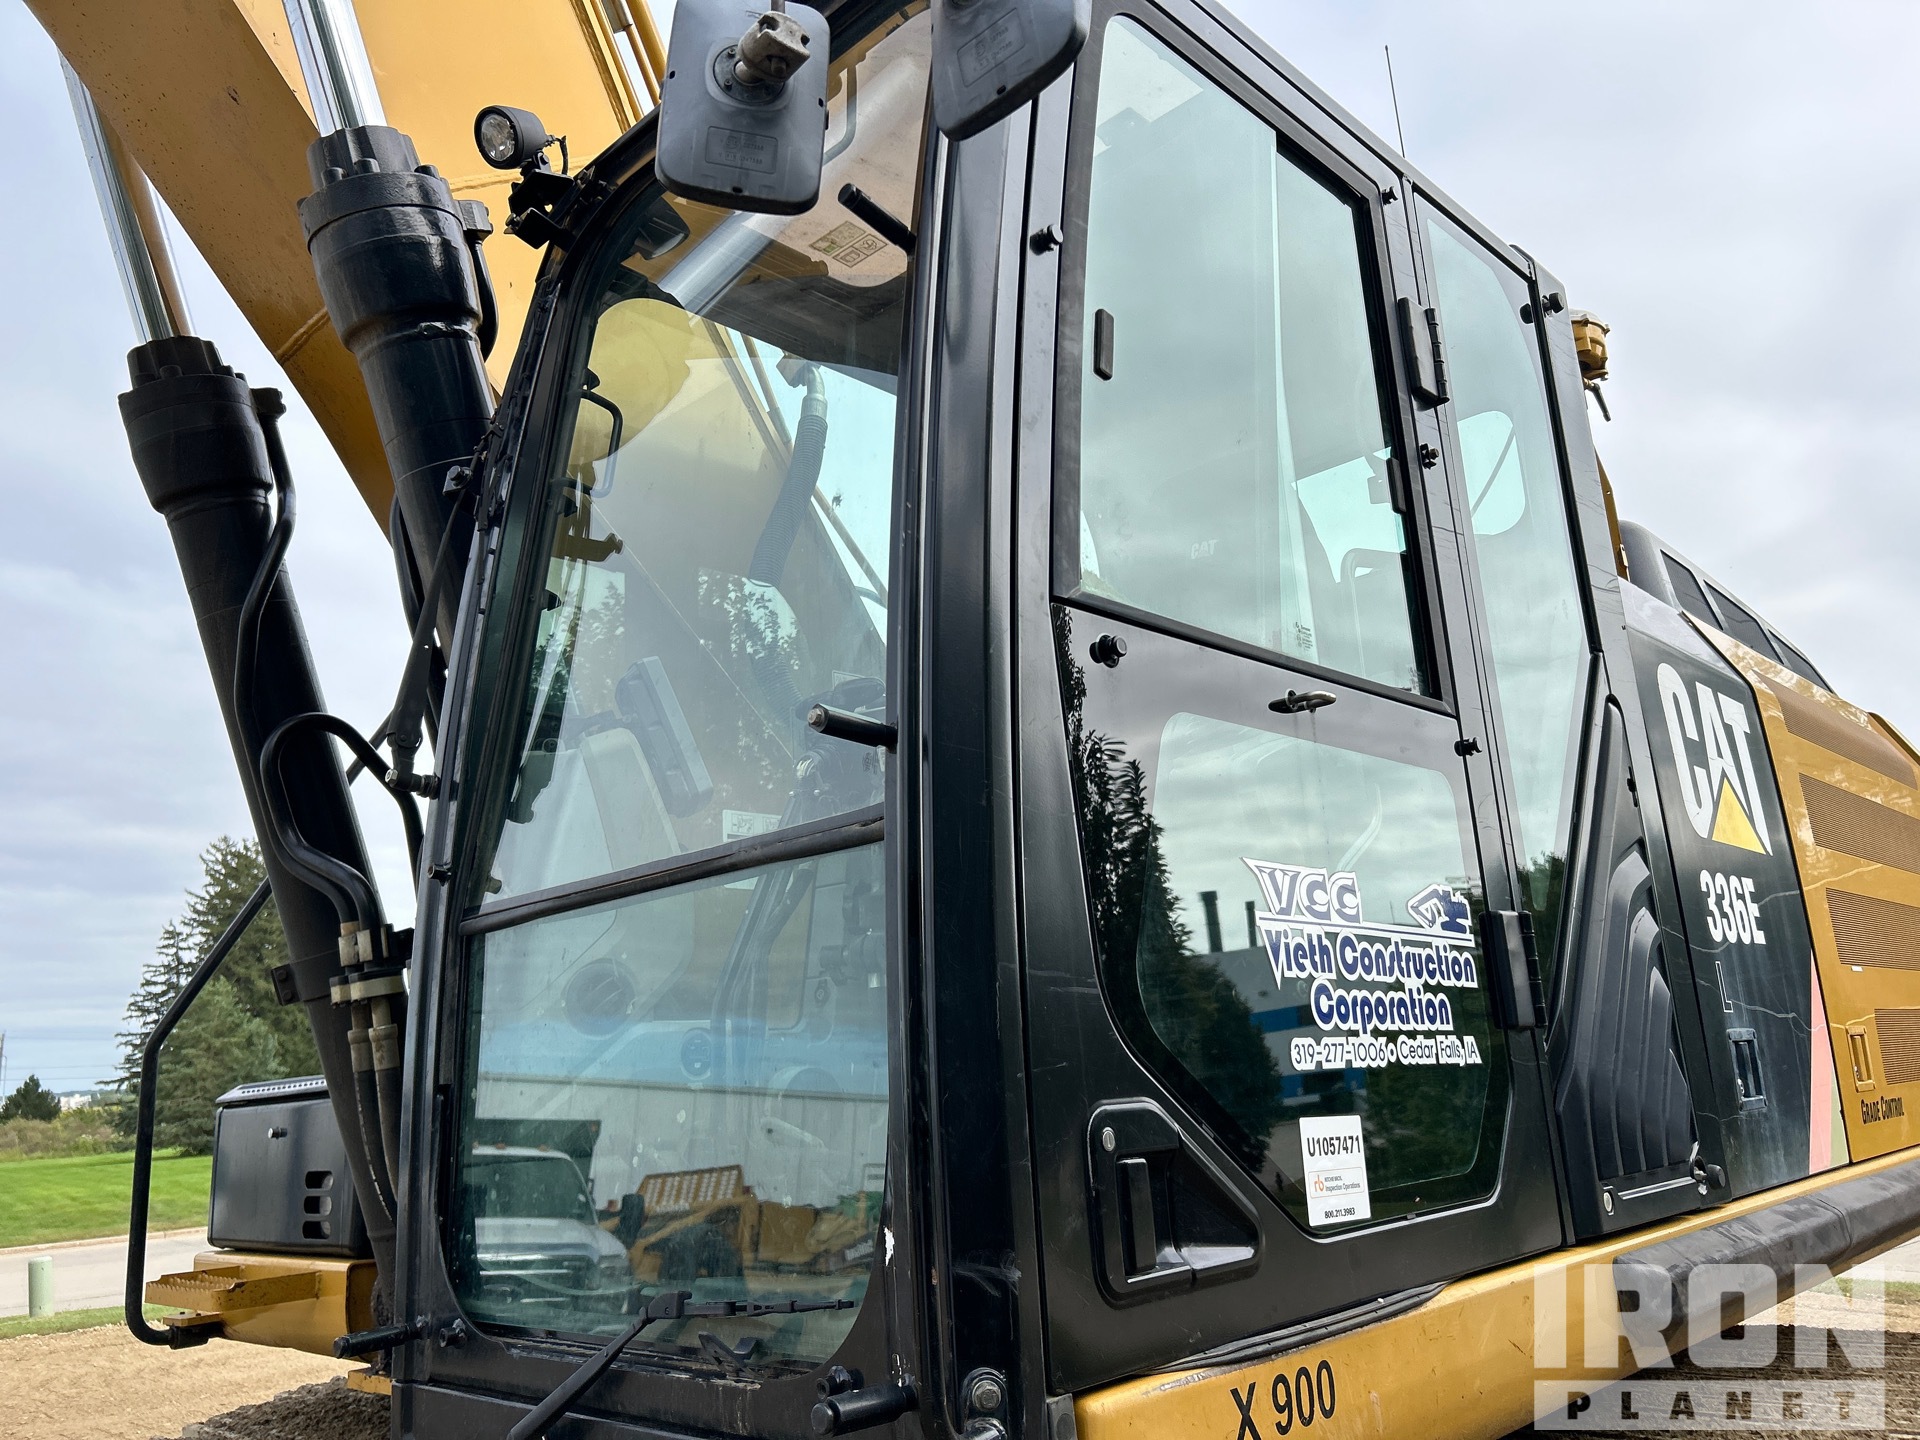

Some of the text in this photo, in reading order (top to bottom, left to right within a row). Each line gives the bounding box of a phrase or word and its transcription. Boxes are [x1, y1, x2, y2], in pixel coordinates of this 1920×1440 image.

[1191, 540, 1218, 559] CAT
[1657, 662, 1773, 856] CAT
[1253, 864, 1361, 924] VCC
[1700, 870, 1766, 945] 336E
[1265, 928, 1475, 983] Vieth Construction
[1314, 983, 1451, 1035] Corporation
[1294, 1042, 1386, 1064] 319-277-1006
[1400, 1041, 1434, 1060] Cedar
[1467, 1042, 1478, 1059] IA
[1307, 1135, 1360, 1157] U1057471
[1230, 1359, 1336, 1440] X 900
